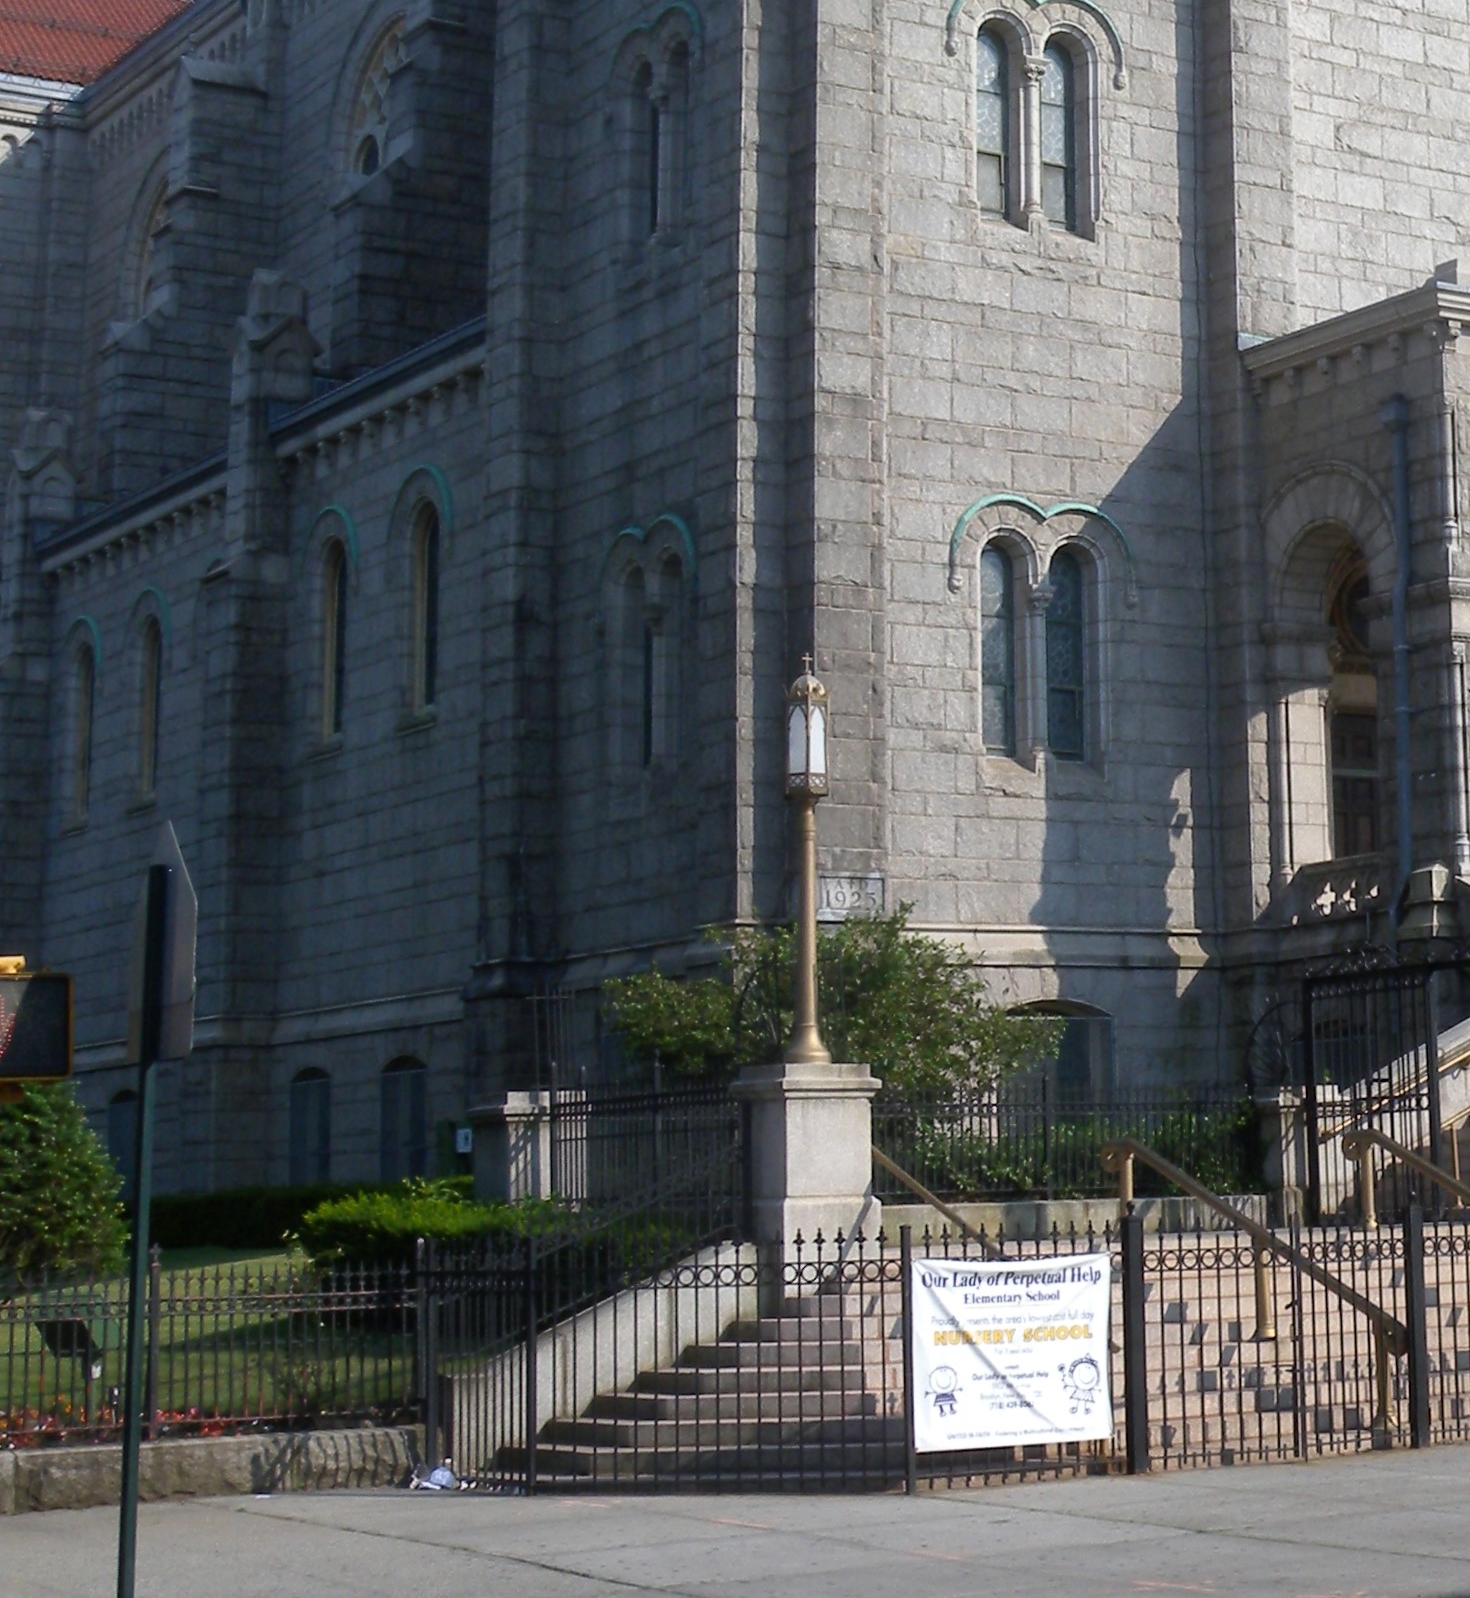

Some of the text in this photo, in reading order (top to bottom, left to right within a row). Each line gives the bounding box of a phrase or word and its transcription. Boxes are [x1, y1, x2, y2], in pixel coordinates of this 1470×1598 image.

[826, 890, 877, 910] 1925
[922, 1266, 1101, 1290] Our Lady of Perpetual Help
[963, 1289, 1060, 1305] Elementary School
[991, 1314, 1003, 1324] the
[1080, 1309, 1095, 1321] day
[933, 1323, 1093, 1346] NURSERY SCHOOL
[1036, 1370, 1049, 1378] Help
